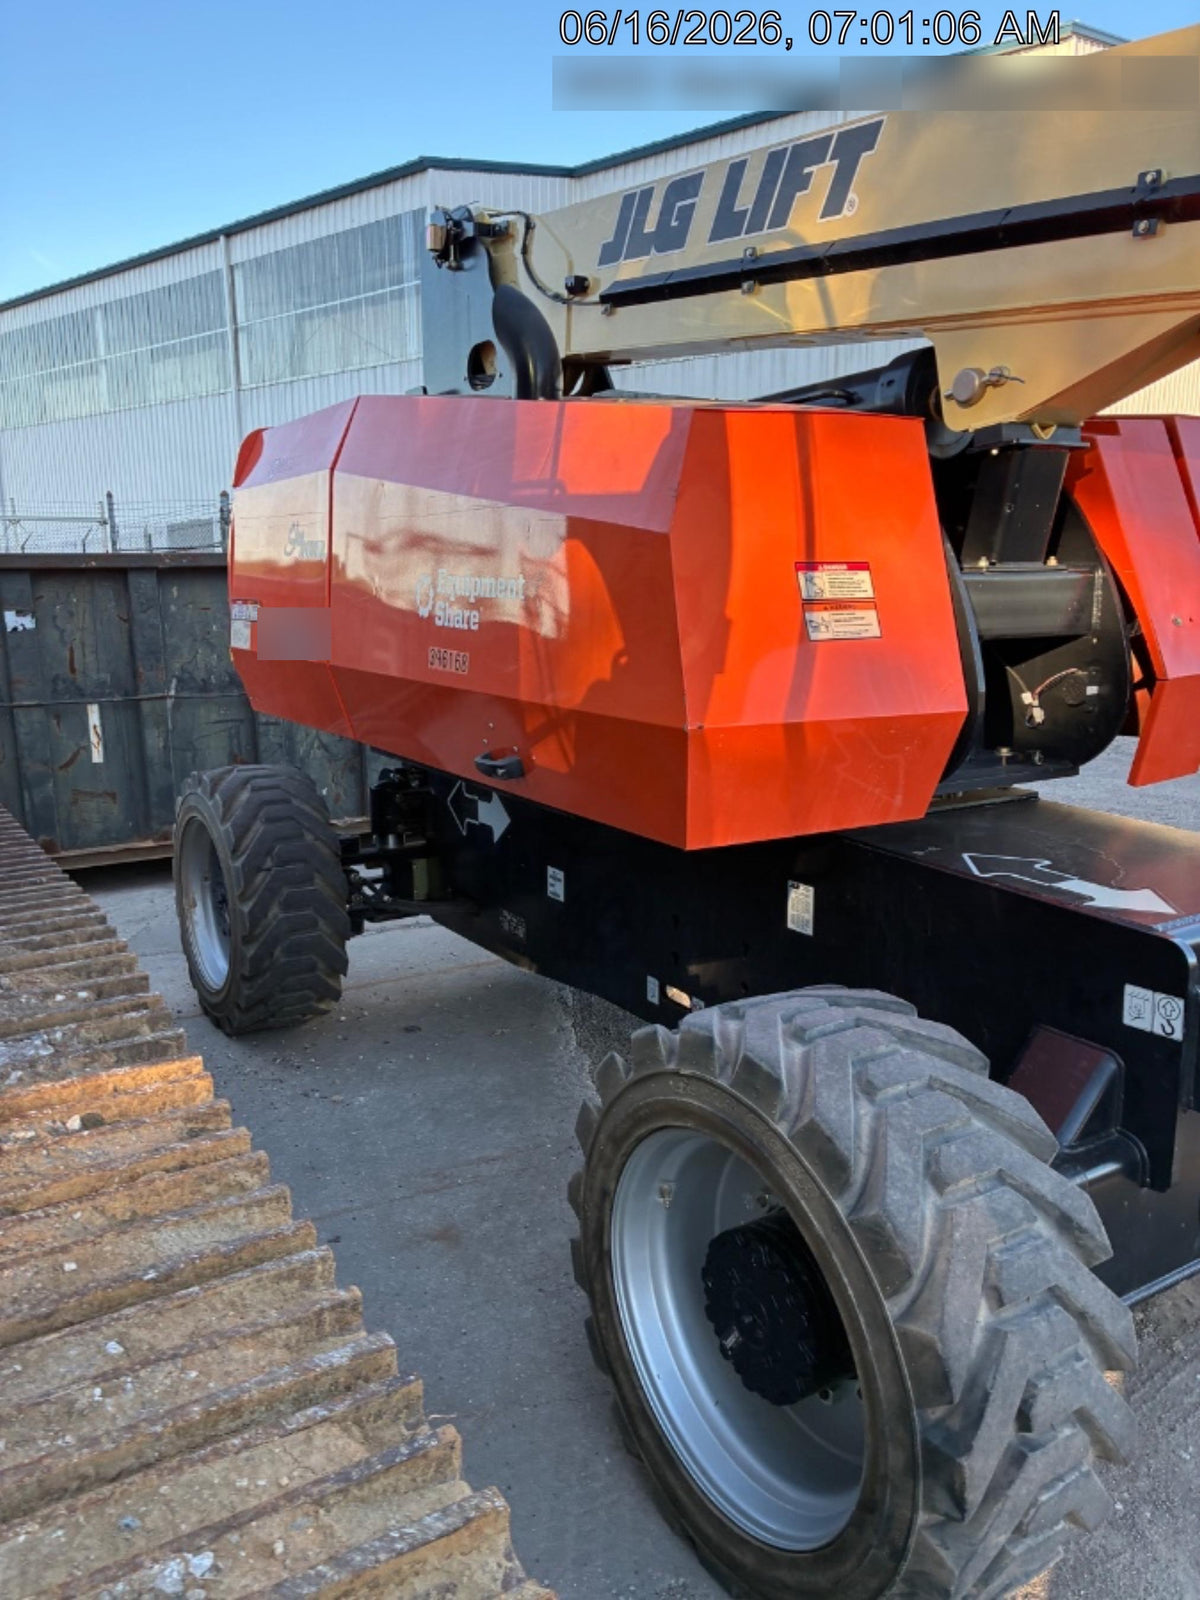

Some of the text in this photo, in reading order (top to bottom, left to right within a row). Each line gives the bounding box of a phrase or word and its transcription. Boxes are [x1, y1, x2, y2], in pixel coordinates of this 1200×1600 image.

[597, 170, 707, 269] JLG
[437, 568, 526, 603] Equipment
[434, 601, 480, 631] Share
